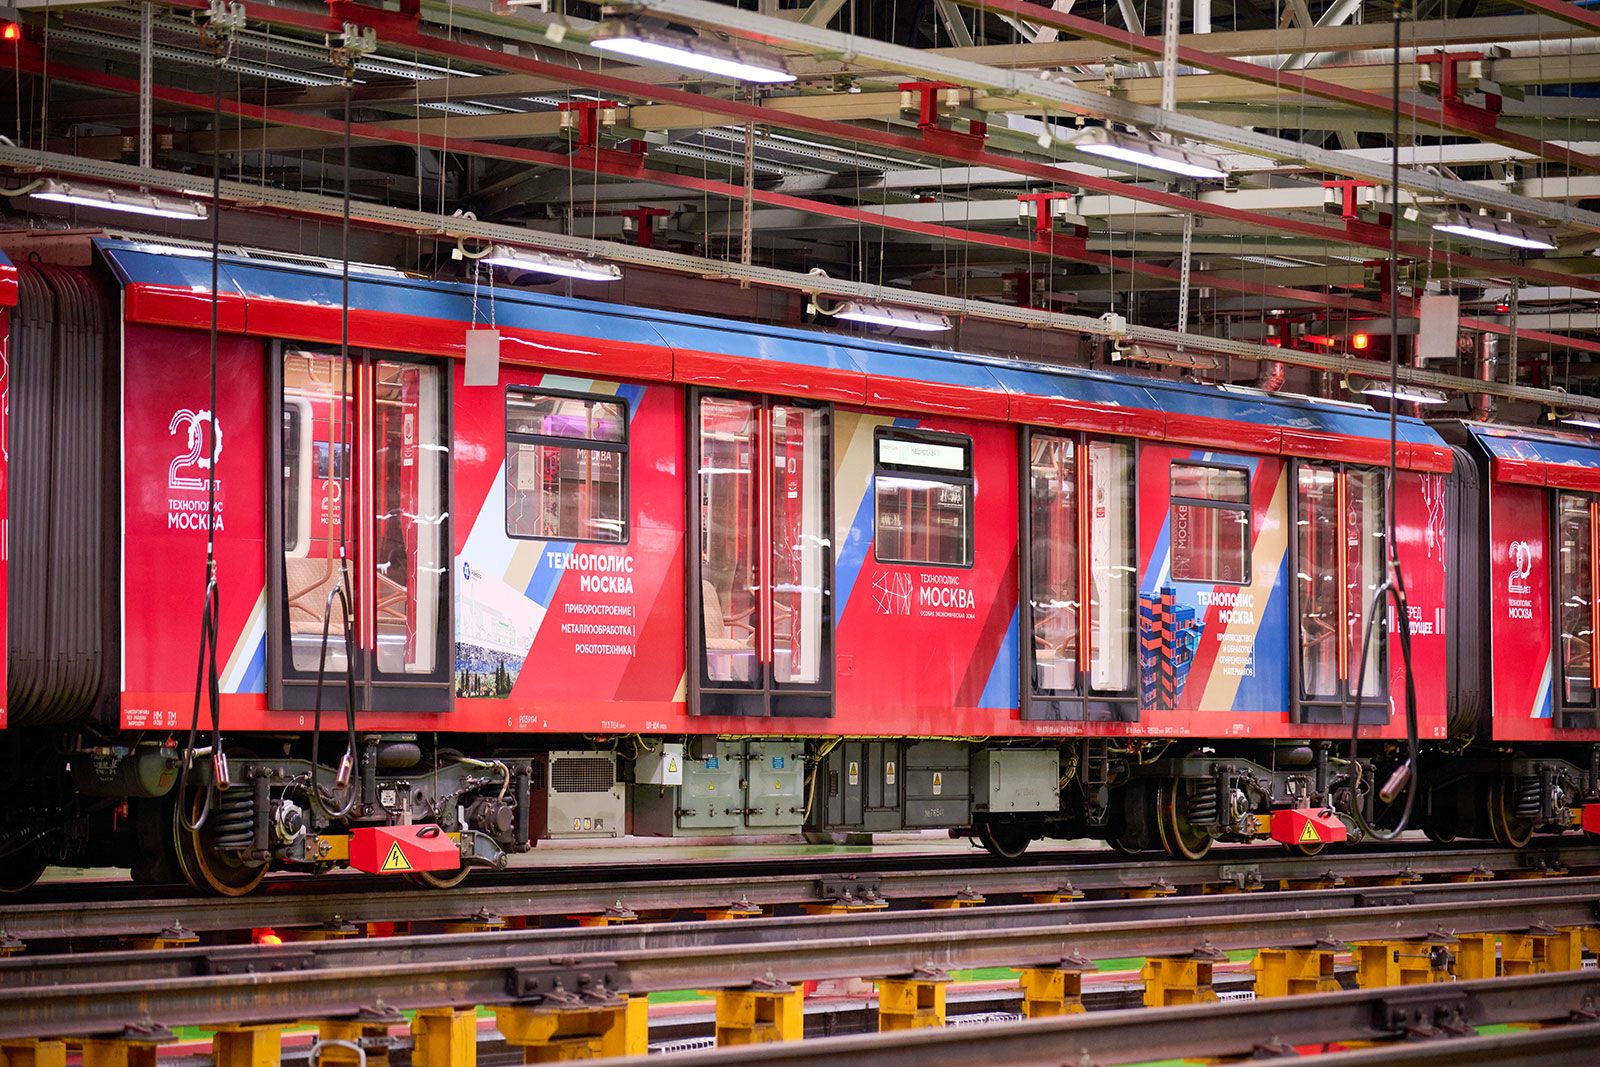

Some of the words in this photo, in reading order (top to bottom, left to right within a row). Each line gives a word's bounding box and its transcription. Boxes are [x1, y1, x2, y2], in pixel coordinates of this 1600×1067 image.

[547, 551, 634, 573] ТЕХНОПОЛИС
[580, 575, 634, 594] МОСКВА
[920, 573, 960, 585] ТЕХНОПОЛИС
[920, 586, 976, 609] МОСКВА
[1197, 591, 1254, 608] ТЕХНОПОЛИС
[564, 603, 632, 616] ПРИБОРОСТРОЕНИЕ
[1508, 608, 1533, 619] МОСКВА
[1219, 609, 1254, 625] МОСКВА
[561, 623, 632, 636] МЕТАЛЛООБРАБОТКА
[575, 643, 633, 656] РОБОТОТЕХНИКА
[299, 714, 305, 726] 8
[507, 716, 513, 728] 6
